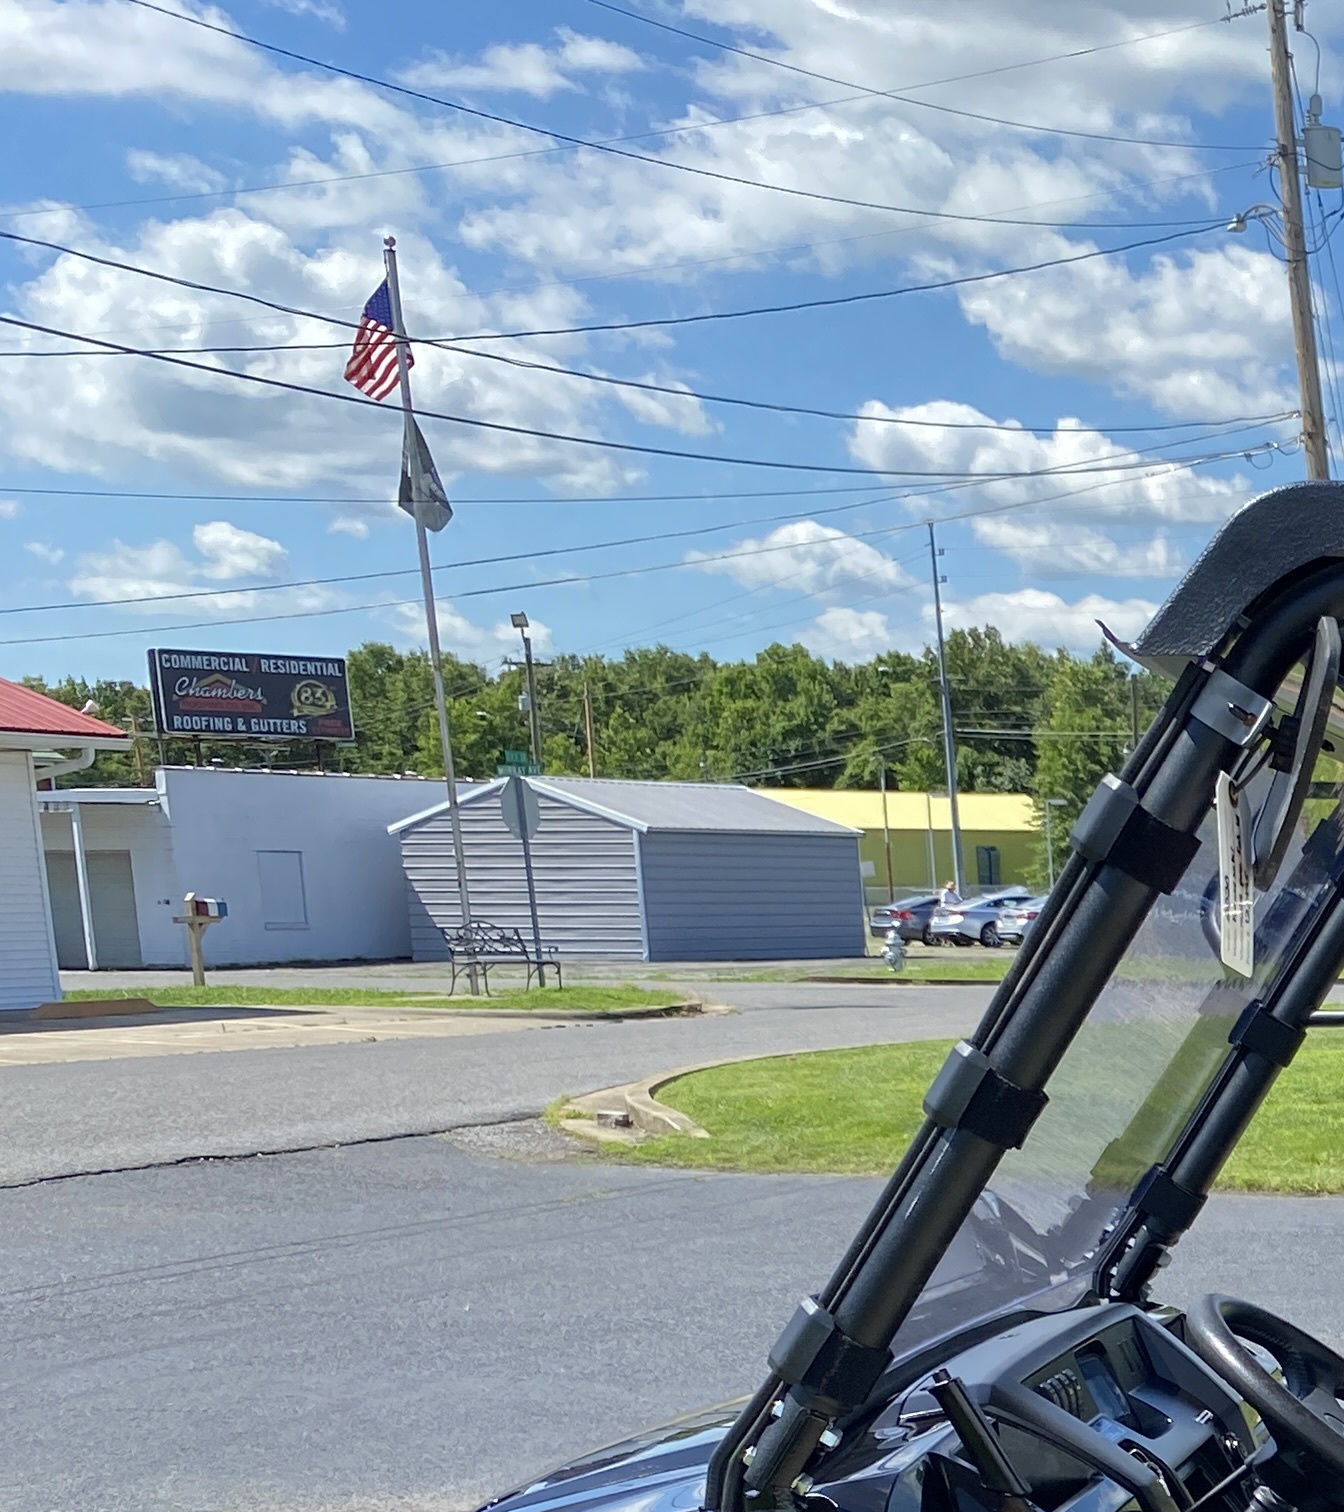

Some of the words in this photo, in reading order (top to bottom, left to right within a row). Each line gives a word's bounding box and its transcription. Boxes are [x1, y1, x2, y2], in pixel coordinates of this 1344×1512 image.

[160, 653, 250, 672] COMMERCIAL
[260, 658, 343, 677] RESIDENTIAL
[174, 676, 264, 701] Chambers
[300, 686, 327, 705] 83
[173, 715, 233, 732] ROOFING
[237, 718, 246, 732] &
[251, 719, 307, 734] GUTTERS
